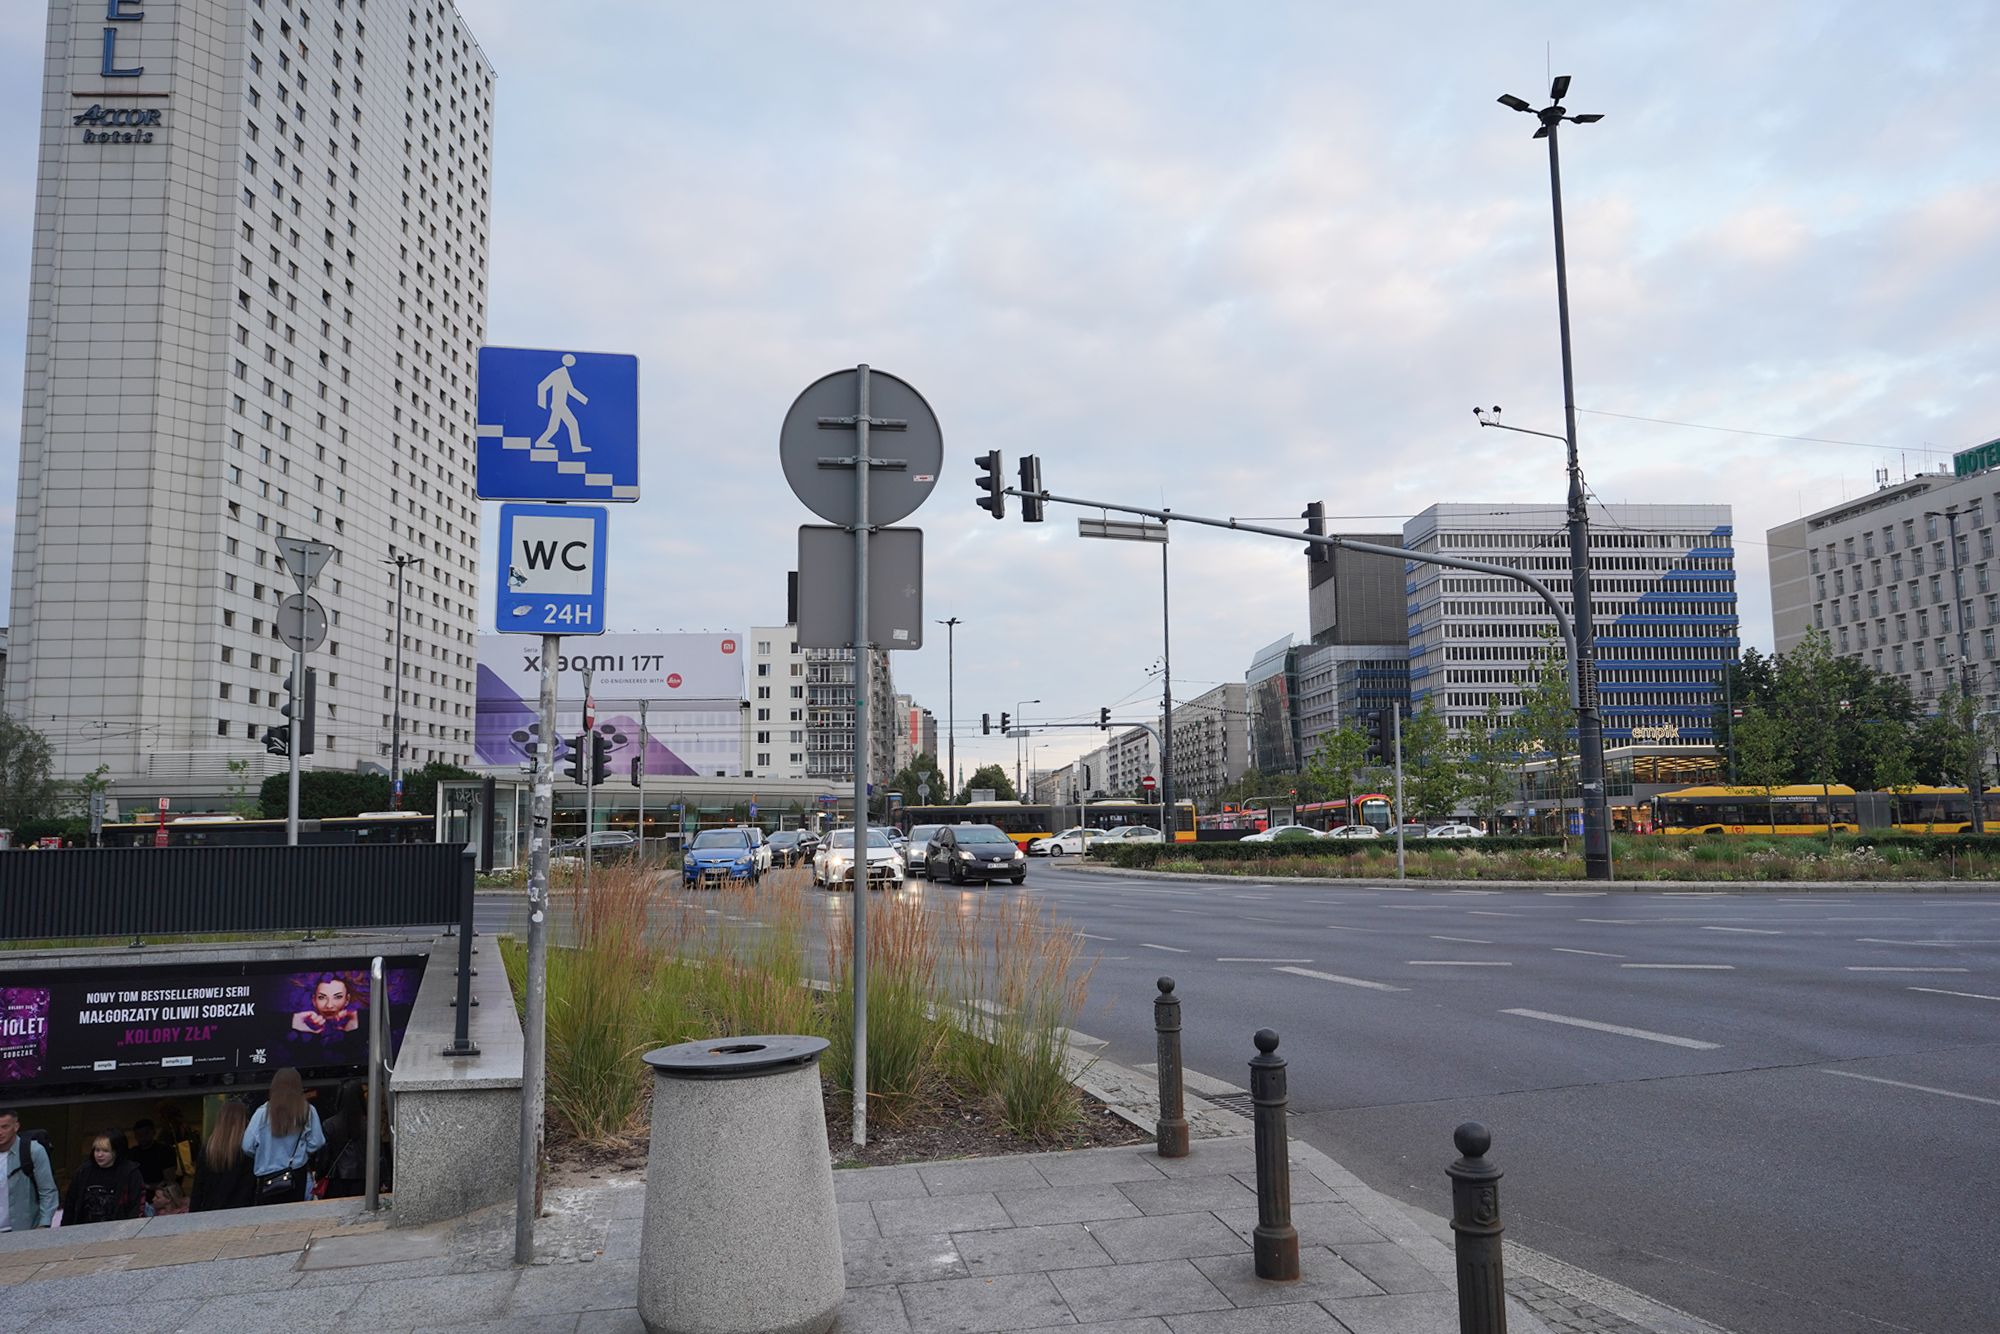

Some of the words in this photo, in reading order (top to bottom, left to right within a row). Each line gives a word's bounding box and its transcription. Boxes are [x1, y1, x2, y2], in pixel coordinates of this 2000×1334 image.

[83, 129, 153, 143] hotels
[522, 540, 588, 572] WC
[543, 603, 592, 625] 24H
[523, 655, 624, 672] xaomi
[631, 655, 664, 671] 17T
[1632, 722, 1679, 741] empik
[86, 991, 116, 1004] NOWY
[118, 990, 139, 1003] TOM
[141, 987, 224, 1002] BESTSELLEROWEJ
[225, 986, 250, 998] SERII
[79, 1007, 159, 1025] MAŁGORZATY
[162, 1005, 199, 1021] OLIWII
[202, 1002, 255, 1018] SOBCZAK
